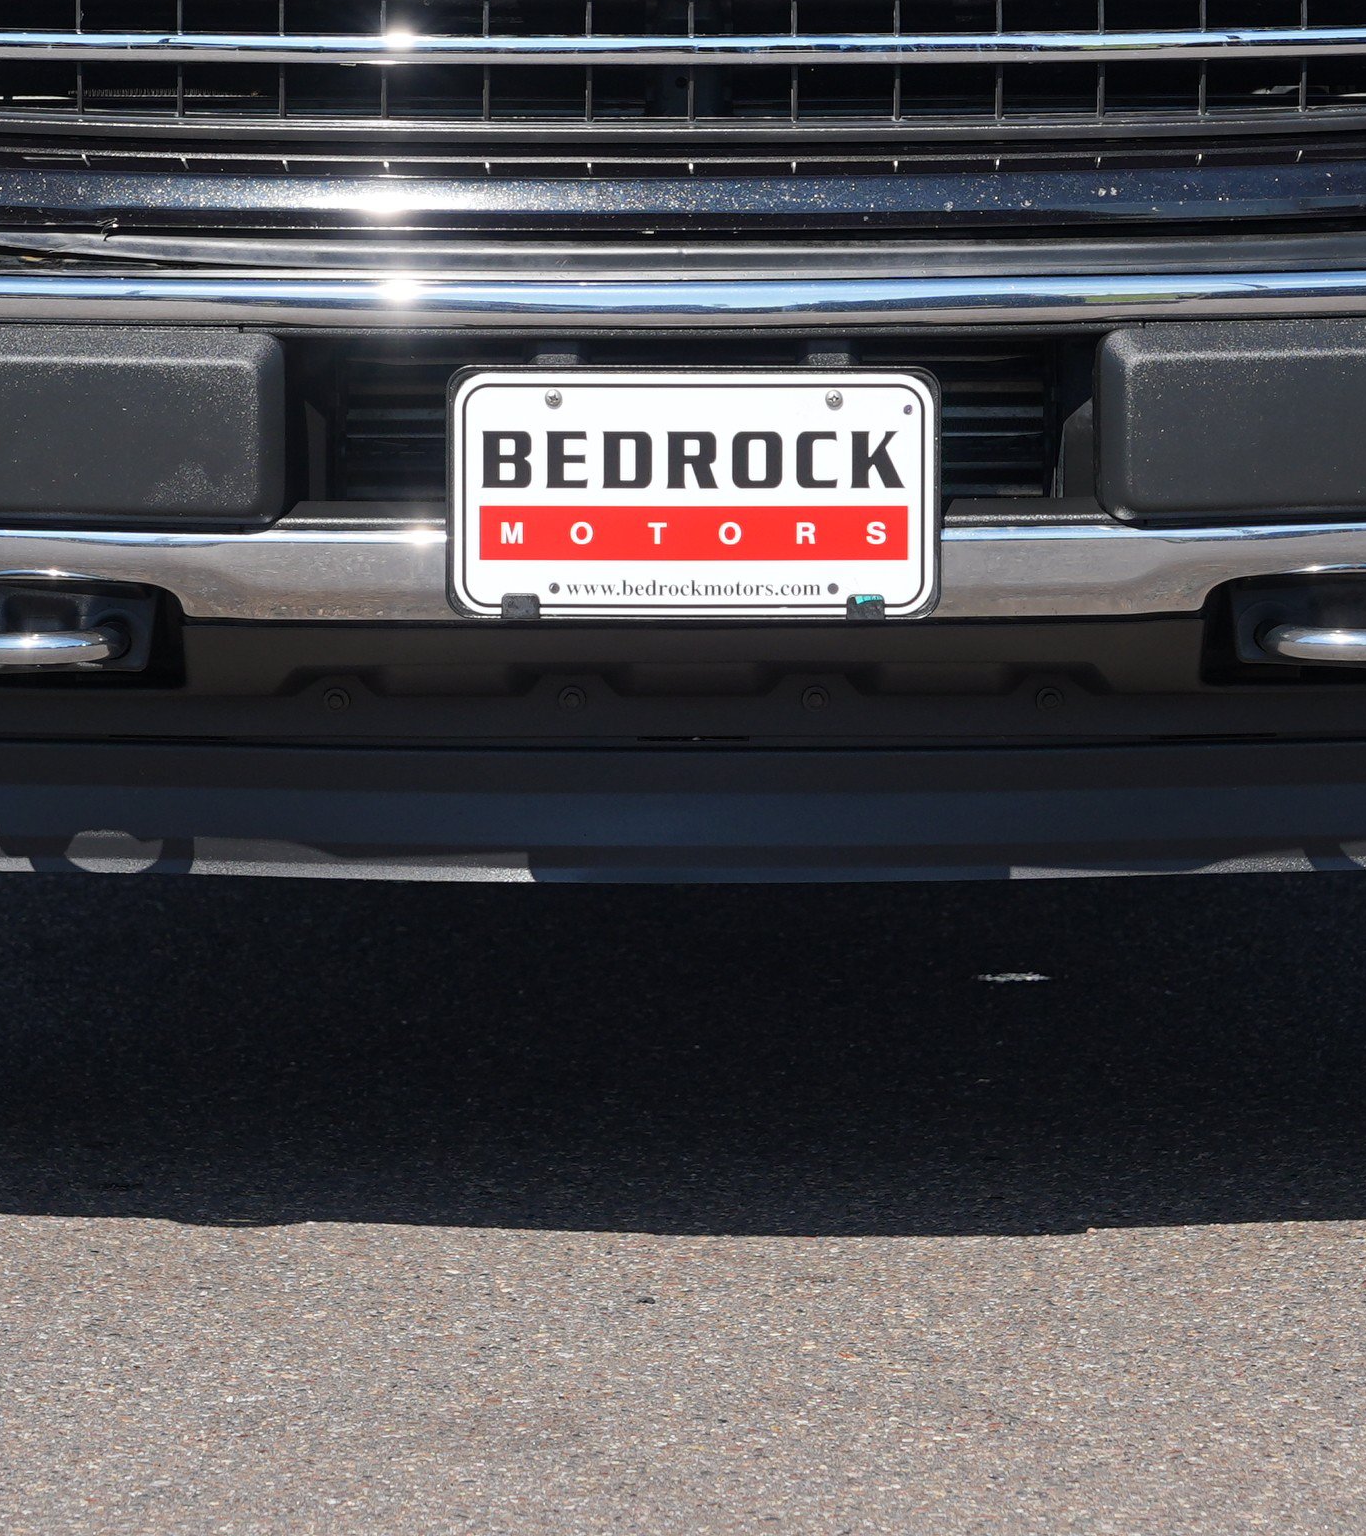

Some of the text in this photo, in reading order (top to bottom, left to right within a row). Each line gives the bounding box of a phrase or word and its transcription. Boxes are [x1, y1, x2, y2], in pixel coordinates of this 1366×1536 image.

[481, 430, 905, 490] BEDROCK
[500, 520, 888, 545] MOTORS
[566, 579, 822, 597] www.bedrockmotors.com
